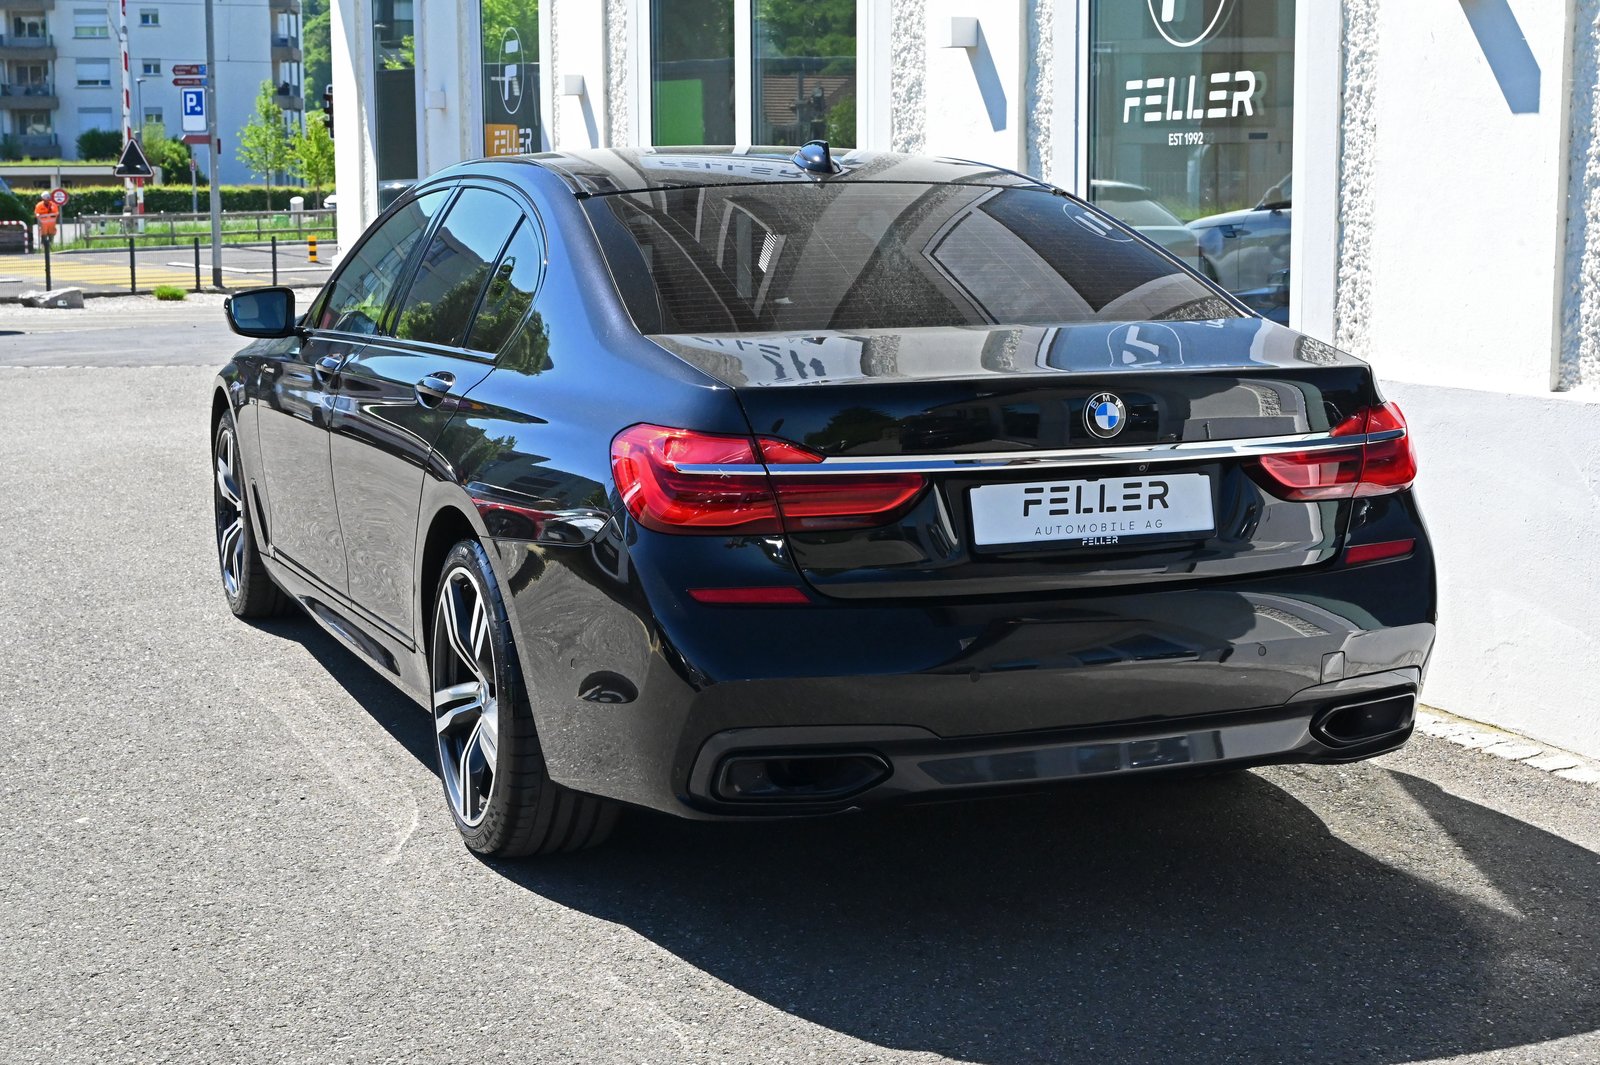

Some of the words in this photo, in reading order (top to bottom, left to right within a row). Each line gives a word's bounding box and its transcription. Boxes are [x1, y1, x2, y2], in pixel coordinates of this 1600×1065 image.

[186, 93, 197, 113] P
[1123, 70, 1256, 124] FELLER
[494, 128, 533, 154] FELLER
[1168, 133, 1183, 146] EST
[1184, 131, 1204, 145] 1992
[1090, 394, 1124, 410] BMW
[1023, 480, 1169, 517] FELLER
[1034, 521, 1136, 536] AUTOMOBILE
[1145, 519, 1164, 529] AG
[1082, 536, 1119, 546] FELLER
